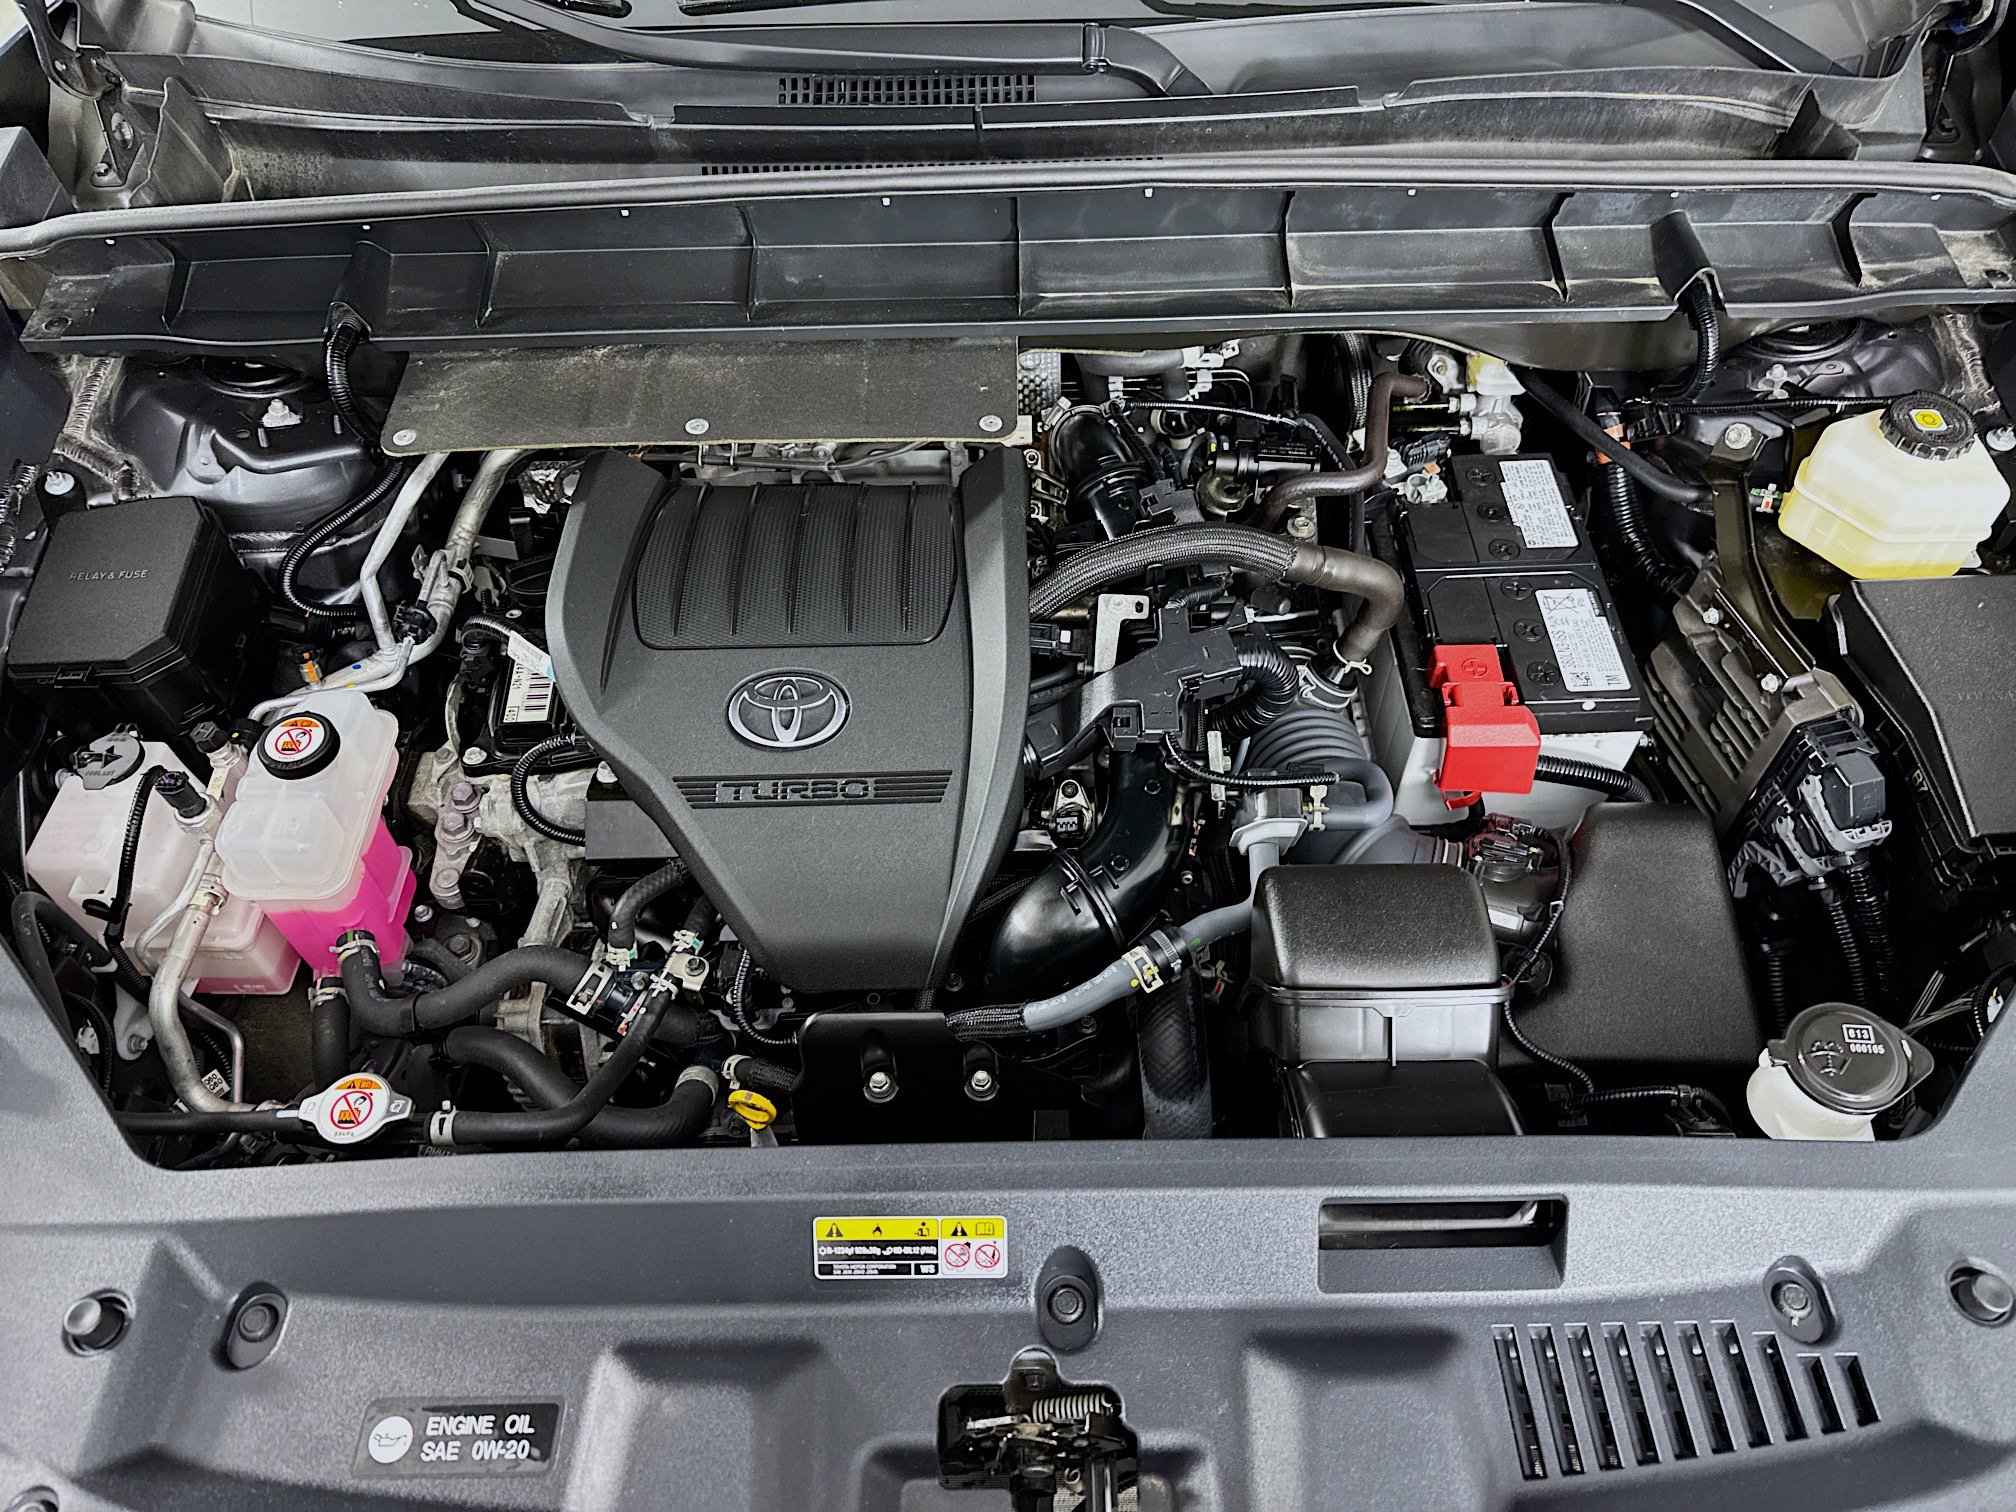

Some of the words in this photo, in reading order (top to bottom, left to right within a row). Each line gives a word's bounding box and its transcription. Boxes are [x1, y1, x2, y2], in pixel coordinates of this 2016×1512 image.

[69, 571, 107, 581] RELAY
[107, 571, 115, 580] &
[118, 569, 149, 580] FUSE
[721, 778, 870, 800] TURBO
[425, 1414, 496, 1436] ENGINE
[504, 1414, 536, 1434] OIL
[420, 1440, 461, 1462] SAE
[471, 1439, 531, 1461] 0W-20
